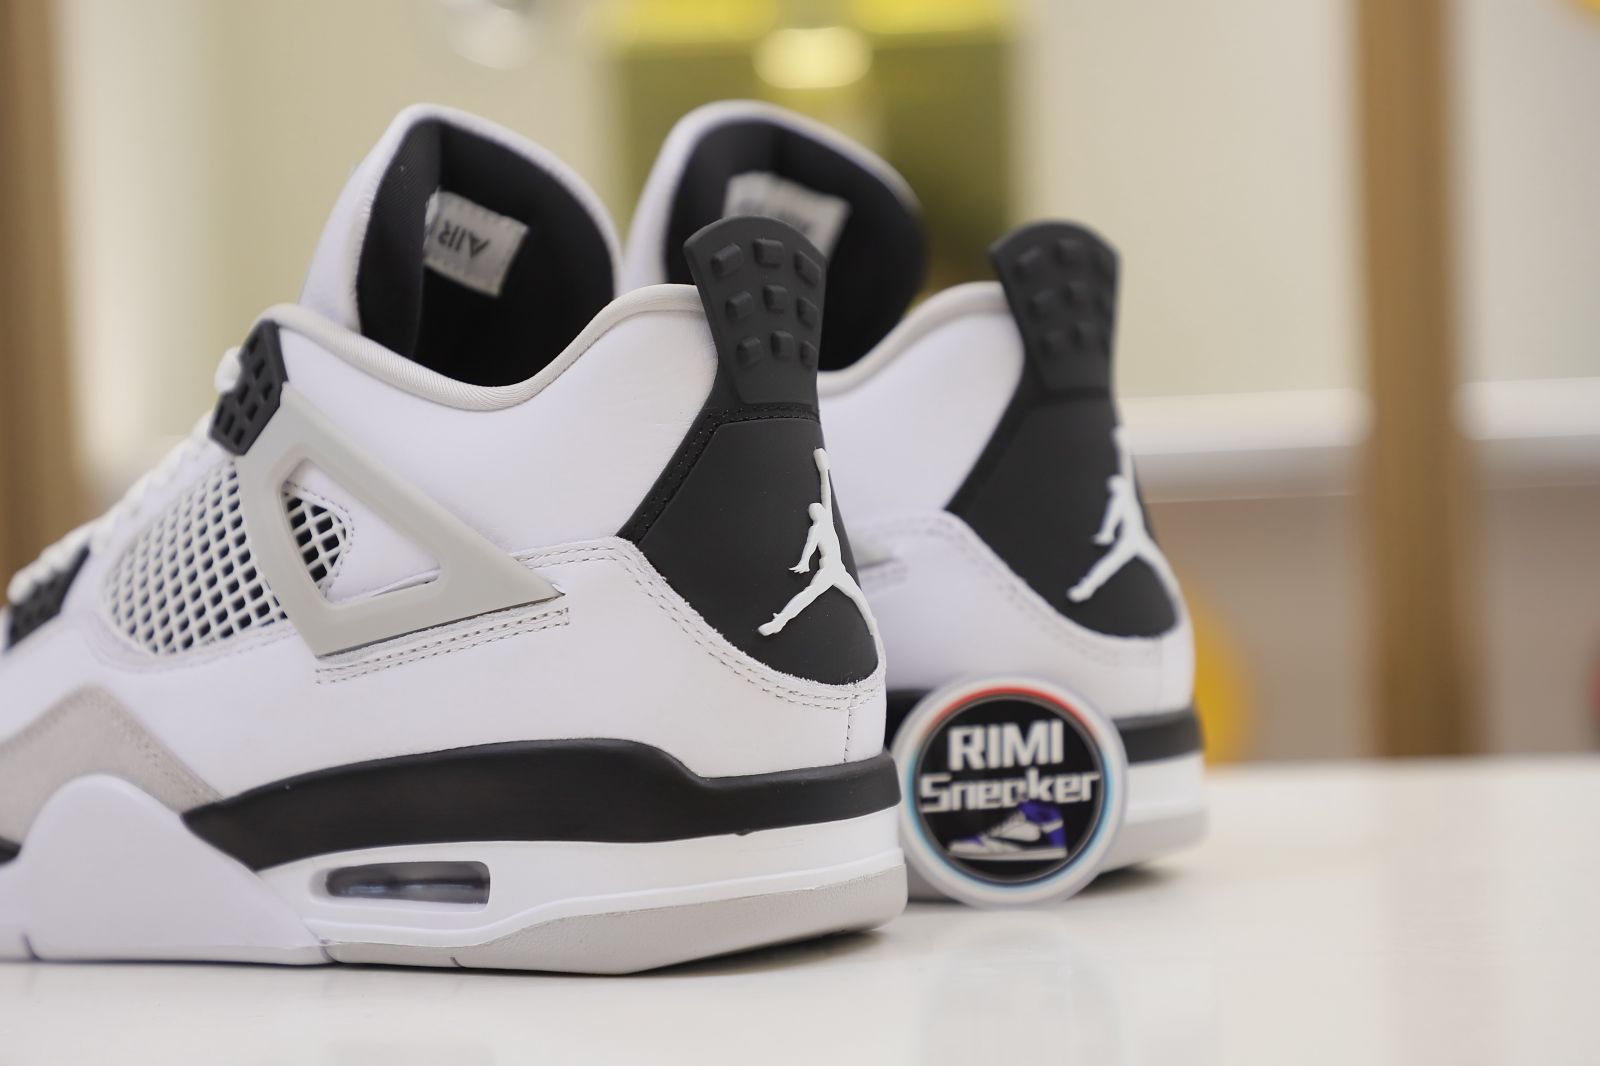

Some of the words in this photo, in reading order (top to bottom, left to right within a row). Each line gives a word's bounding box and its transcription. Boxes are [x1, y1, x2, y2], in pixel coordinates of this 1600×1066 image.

[437, 219, 490, 259] AIR
[948, 719, 1064, 771] RIMI
[919, 767, 1101, 813] Sneaker
